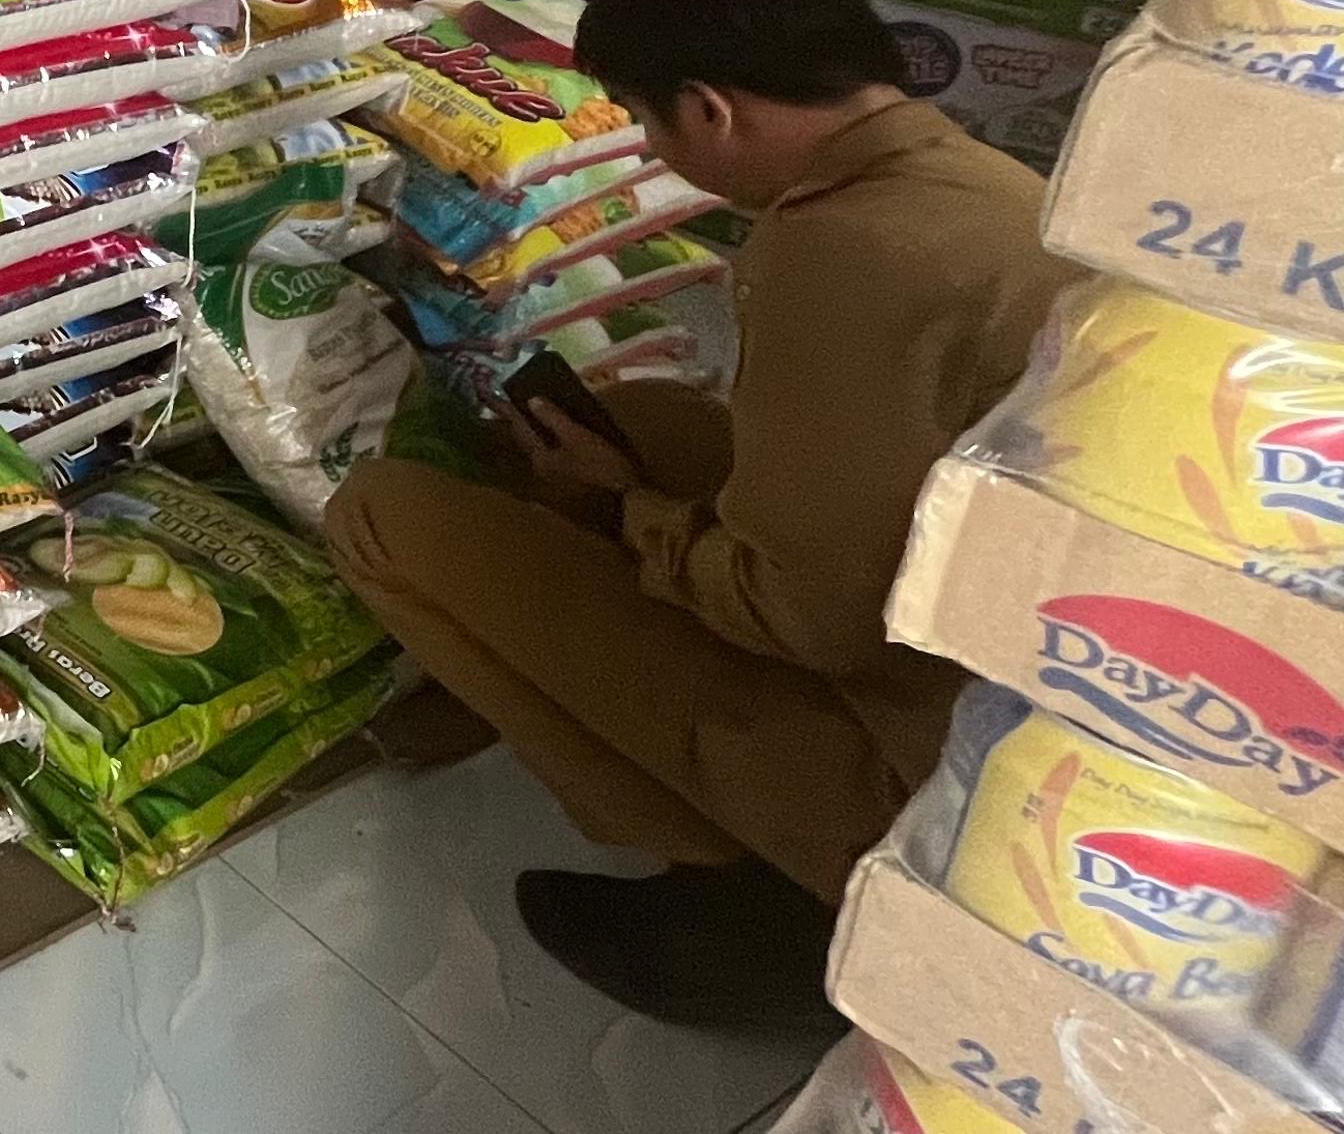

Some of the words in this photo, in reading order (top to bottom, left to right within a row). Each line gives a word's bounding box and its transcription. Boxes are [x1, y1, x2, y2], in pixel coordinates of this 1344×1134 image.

[1136, 200, 1247, 276] 24
[47, 649, 113, 701] Beras
[1037, 616, 1339, 797] DayDay
[949, 1038, 1043, 1120] 24
